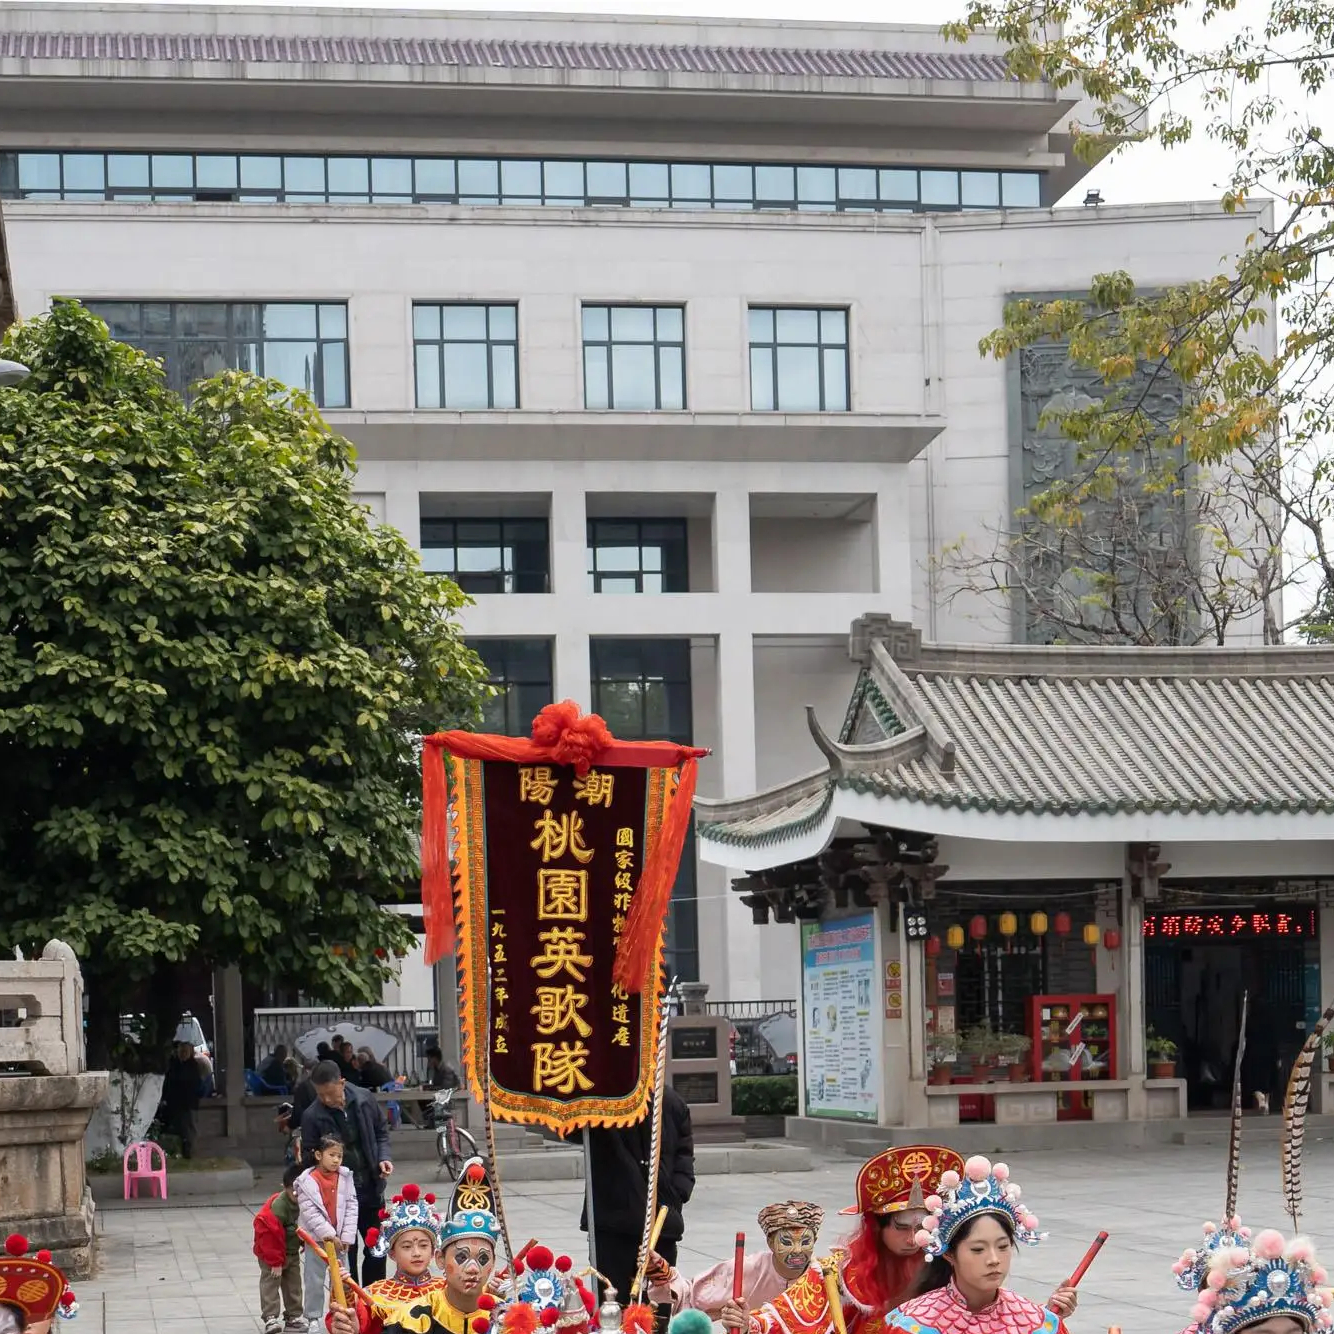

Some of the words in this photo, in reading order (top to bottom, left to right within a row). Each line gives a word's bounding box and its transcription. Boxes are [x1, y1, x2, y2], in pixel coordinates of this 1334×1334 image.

[518, 767, 615, 808] 潮陽
[491, 909, 510, 1053] 一九五二年成立
[530, 809, 594, 1094] 桃園英歌隊
